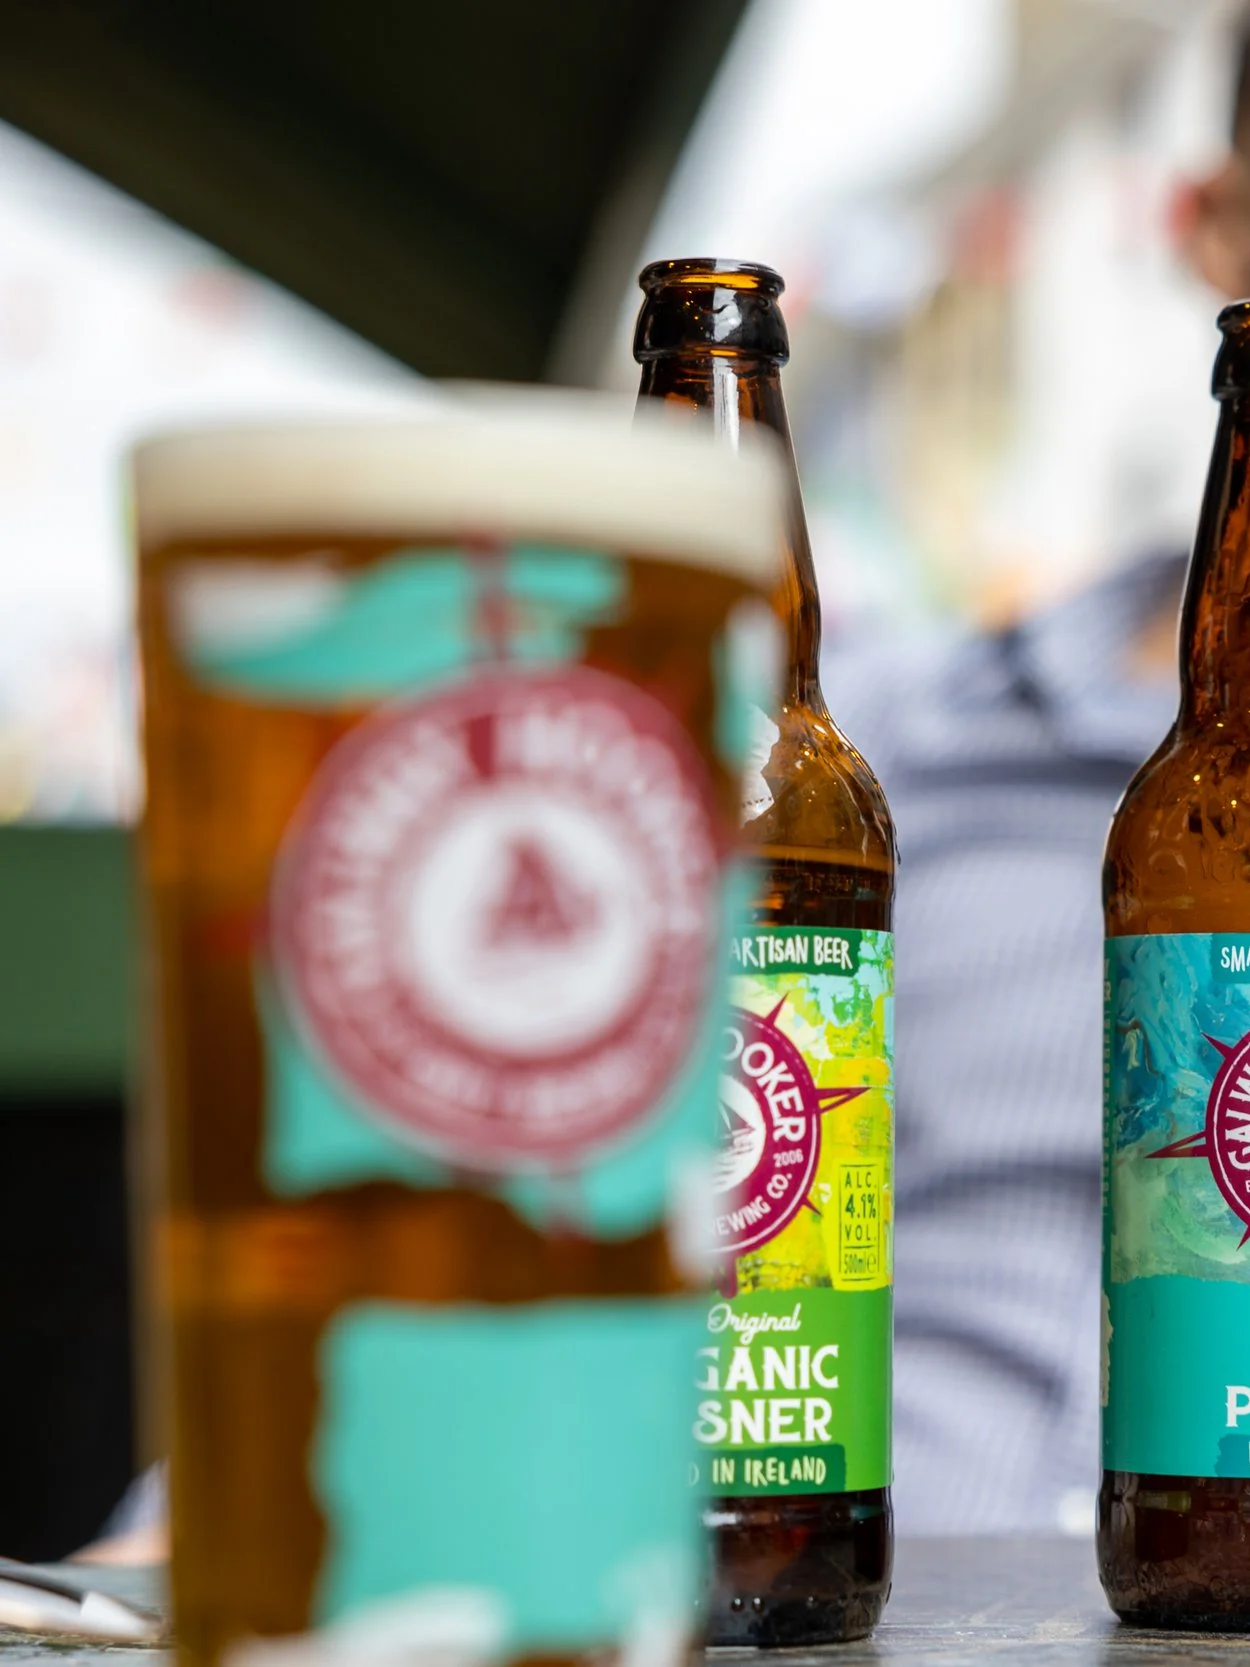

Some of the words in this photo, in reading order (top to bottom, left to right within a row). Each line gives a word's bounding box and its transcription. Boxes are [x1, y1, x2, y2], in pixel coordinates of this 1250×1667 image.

[730, 934, 808, 969] ARTISAN
[813, 935, 854, 970] BEER
[721, 1026, 807, 1143] OOKER
[773, 1148, 804, 1168] 2006
[766, 1172, 793, 1200] CO.
[845, 1193, 877, 1219] 4.1%
[706, 1302, 802, 1345] Original
[695, 1344, 840, 1392] GANIC
[711, 1457, 735, 1485] IN
[744, 1455, 827, 1488] IRELAND
